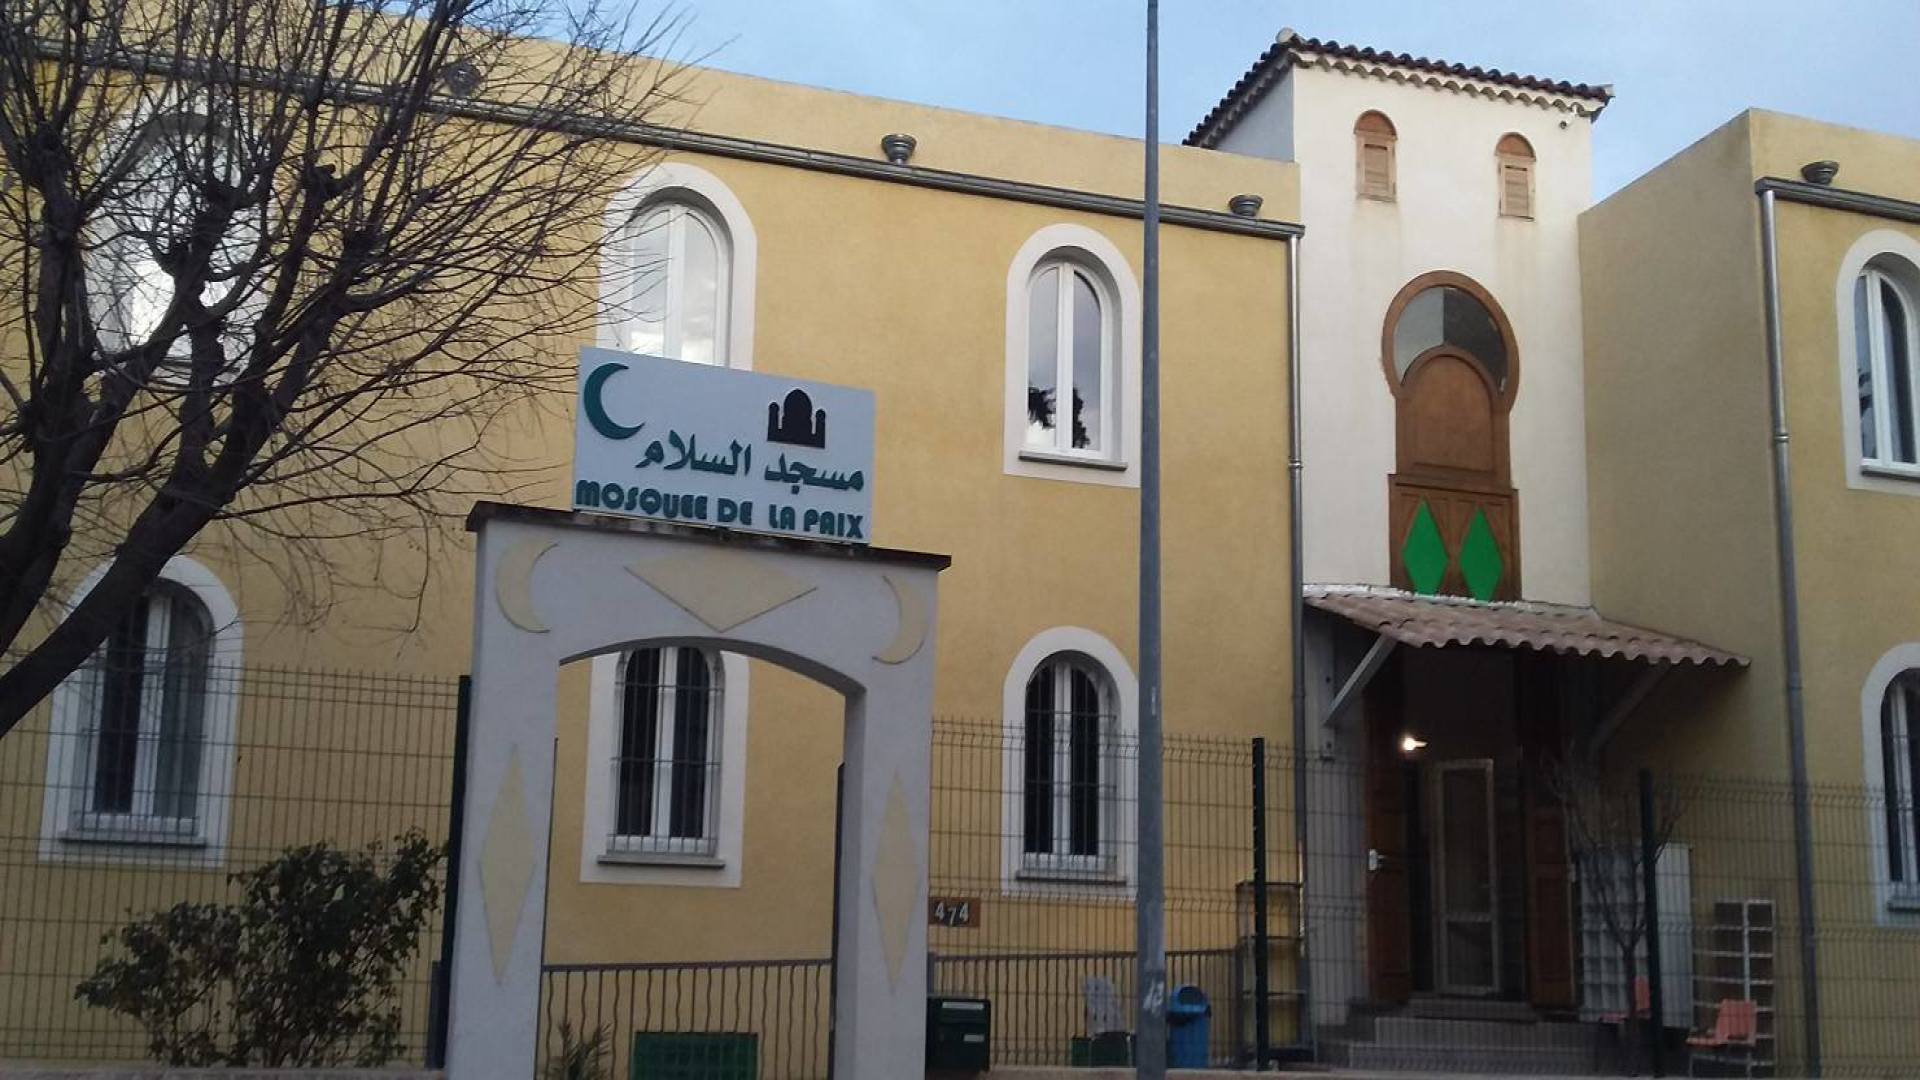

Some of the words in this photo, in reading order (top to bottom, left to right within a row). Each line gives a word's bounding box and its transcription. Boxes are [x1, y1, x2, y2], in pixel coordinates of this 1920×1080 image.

[635, 430, 751, 476] السلام
[764, 453, 864, 495] مسجد
[576, 480, 708, 519] MOSQUEE
[717, 498, 752, 526] DE
[768, 504, 796, 531] LA
[803, 509, 864, 539] PAIX
[935, 901, 969, 925] 474
